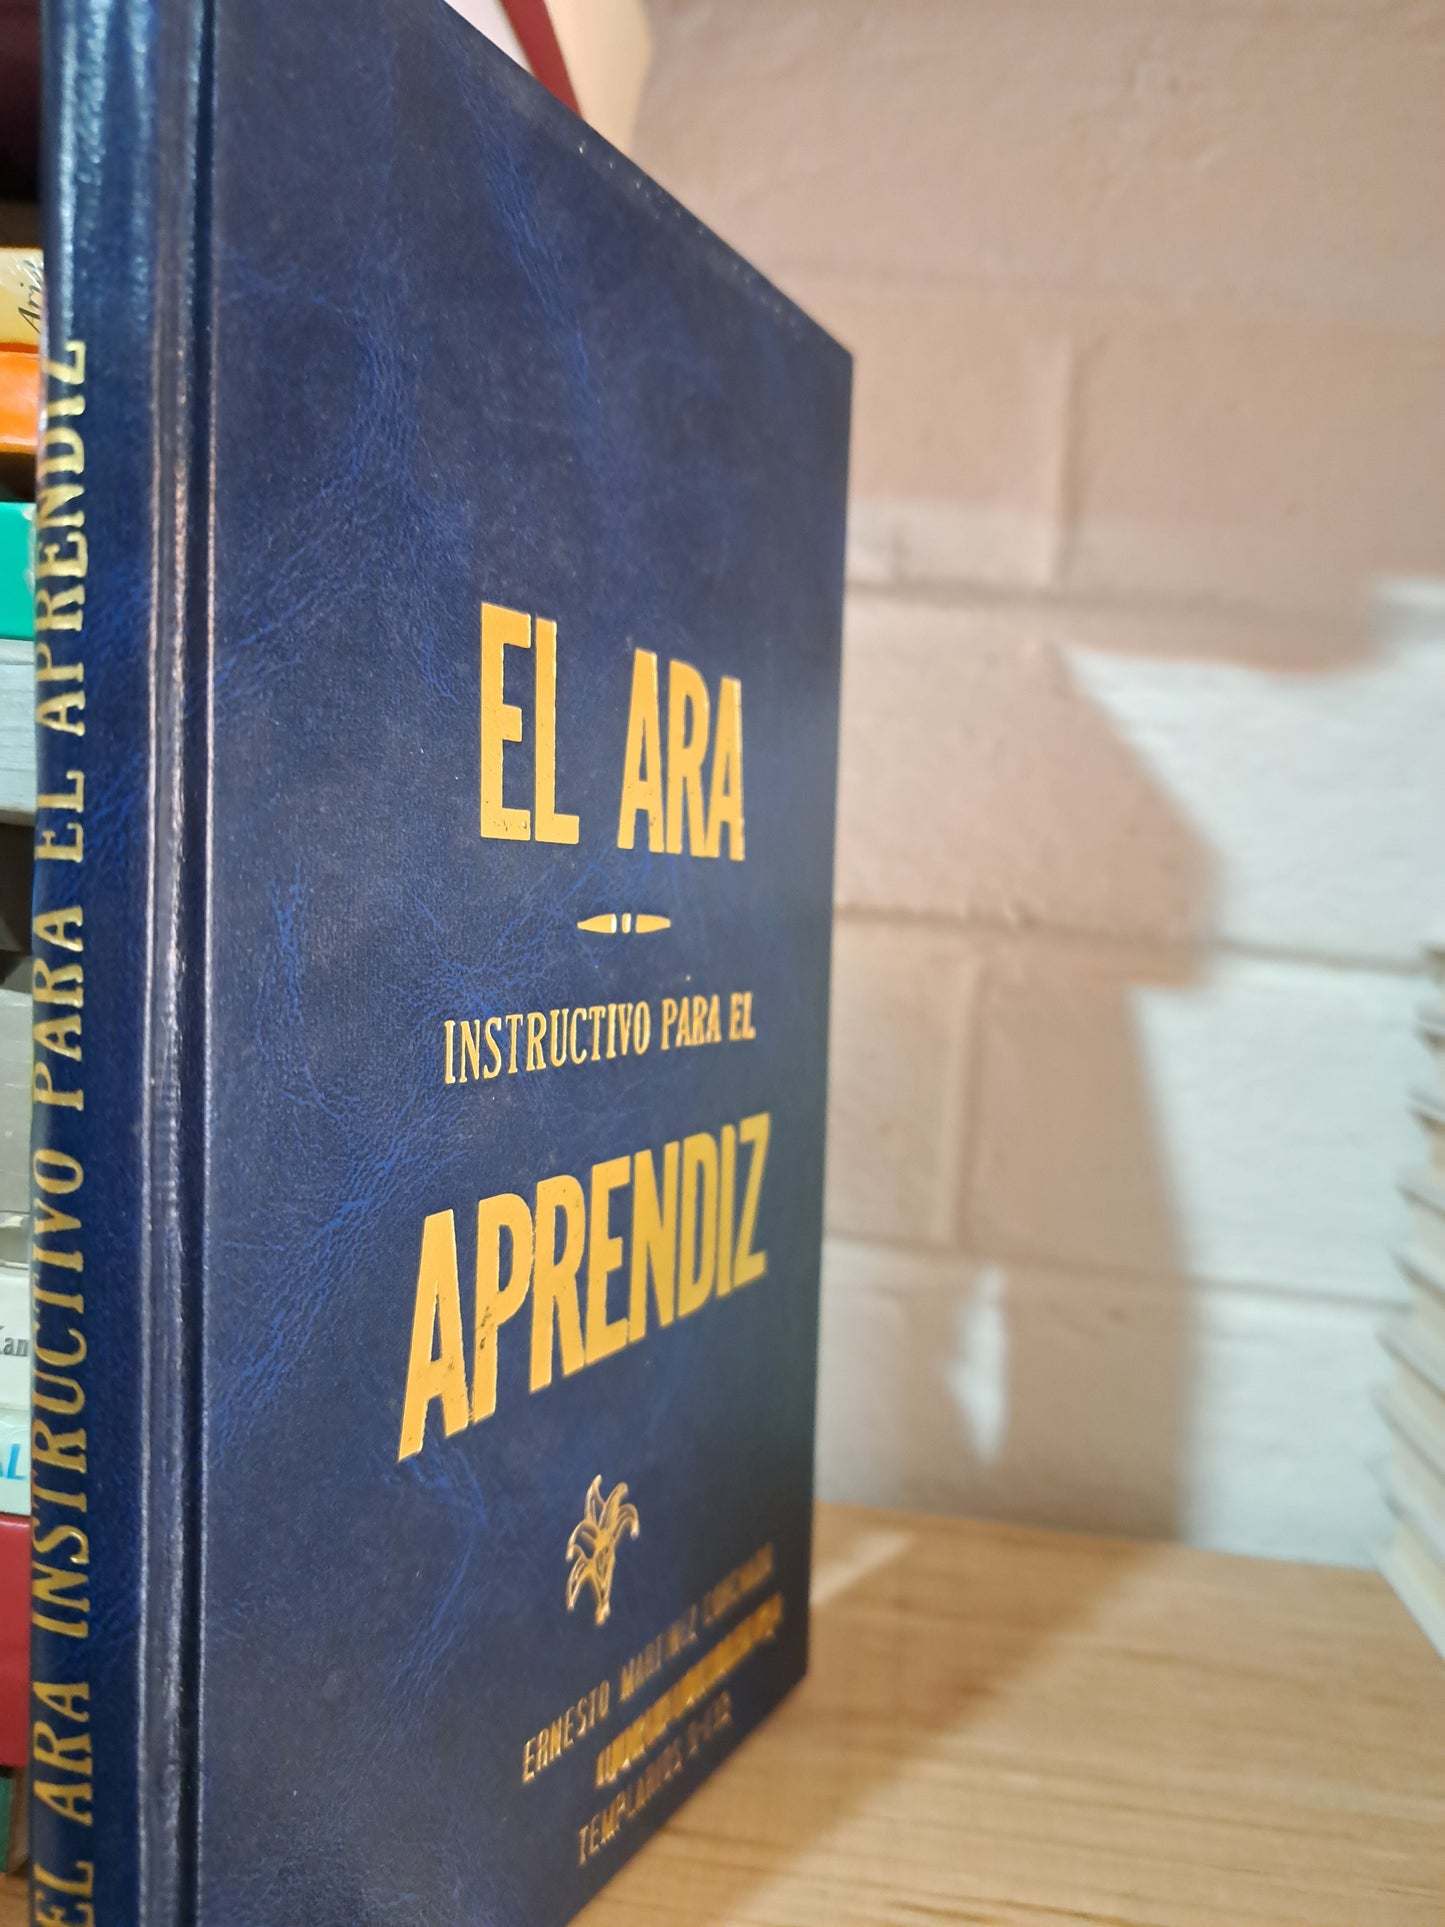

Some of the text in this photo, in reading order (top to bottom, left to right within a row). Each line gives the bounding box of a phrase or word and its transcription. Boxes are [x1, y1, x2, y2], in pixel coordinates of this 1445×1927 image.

[481, 601, 745, 861] EL ARA
[31, 340, 95, 1927] EL ARA INSTRUCTIVO PARA EL APRENDIZ
[444, 992, 756, 1084] INSTRUCTIVO PARA EL
[398, 1112, 771, 1462] APRENDIZ
[522, 1679, 610, 1785] ERNESTO
